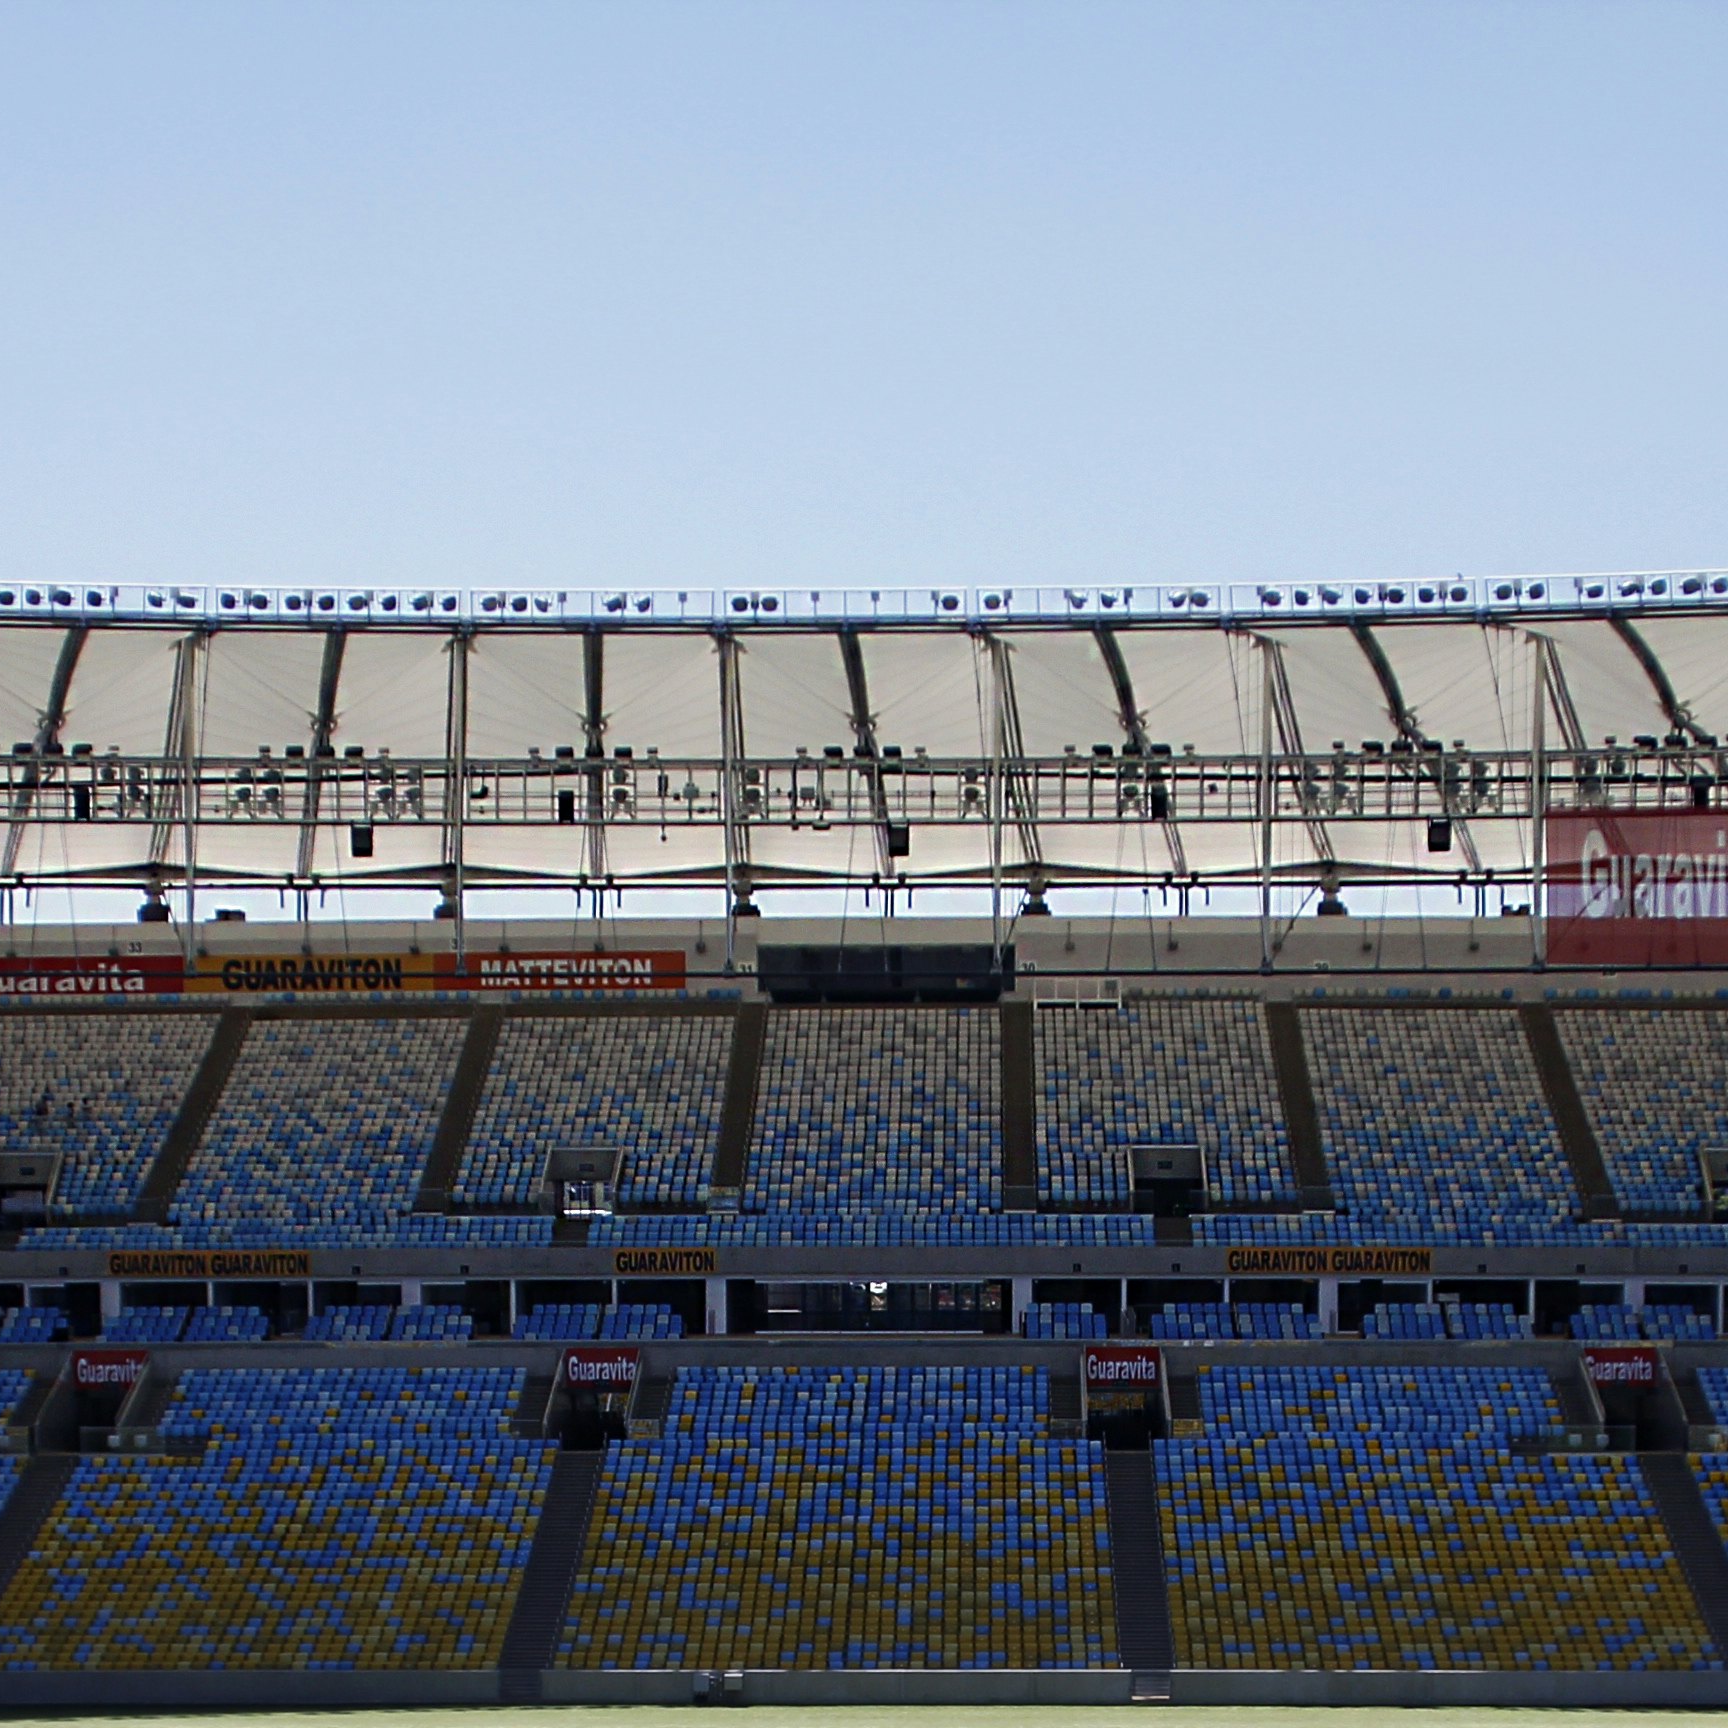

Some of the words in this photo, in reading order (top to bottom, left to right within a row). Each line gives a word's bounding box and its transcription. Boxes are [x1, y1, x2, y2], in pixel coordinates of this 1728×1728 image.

[129, 942, 143, 953] 33
[221, 958, 403, 991] GUARAVITON
[480, 958, 653, 987] MATTEVITON
[109, 1254, 205, 1275] GUARAVITON
[210, 1254, 308, 1275] GUARAVITON
[615, 1251, 714, 1272] GUARAVITON
[1228, 1250, 1327, 1271] GUARAVITON
[1331, 1250, 1431, 1271] GUARAVITON
[568, 1356, 637, 1381] Guaravita
[1087, 1354, 1156, 1380] Guaravita
